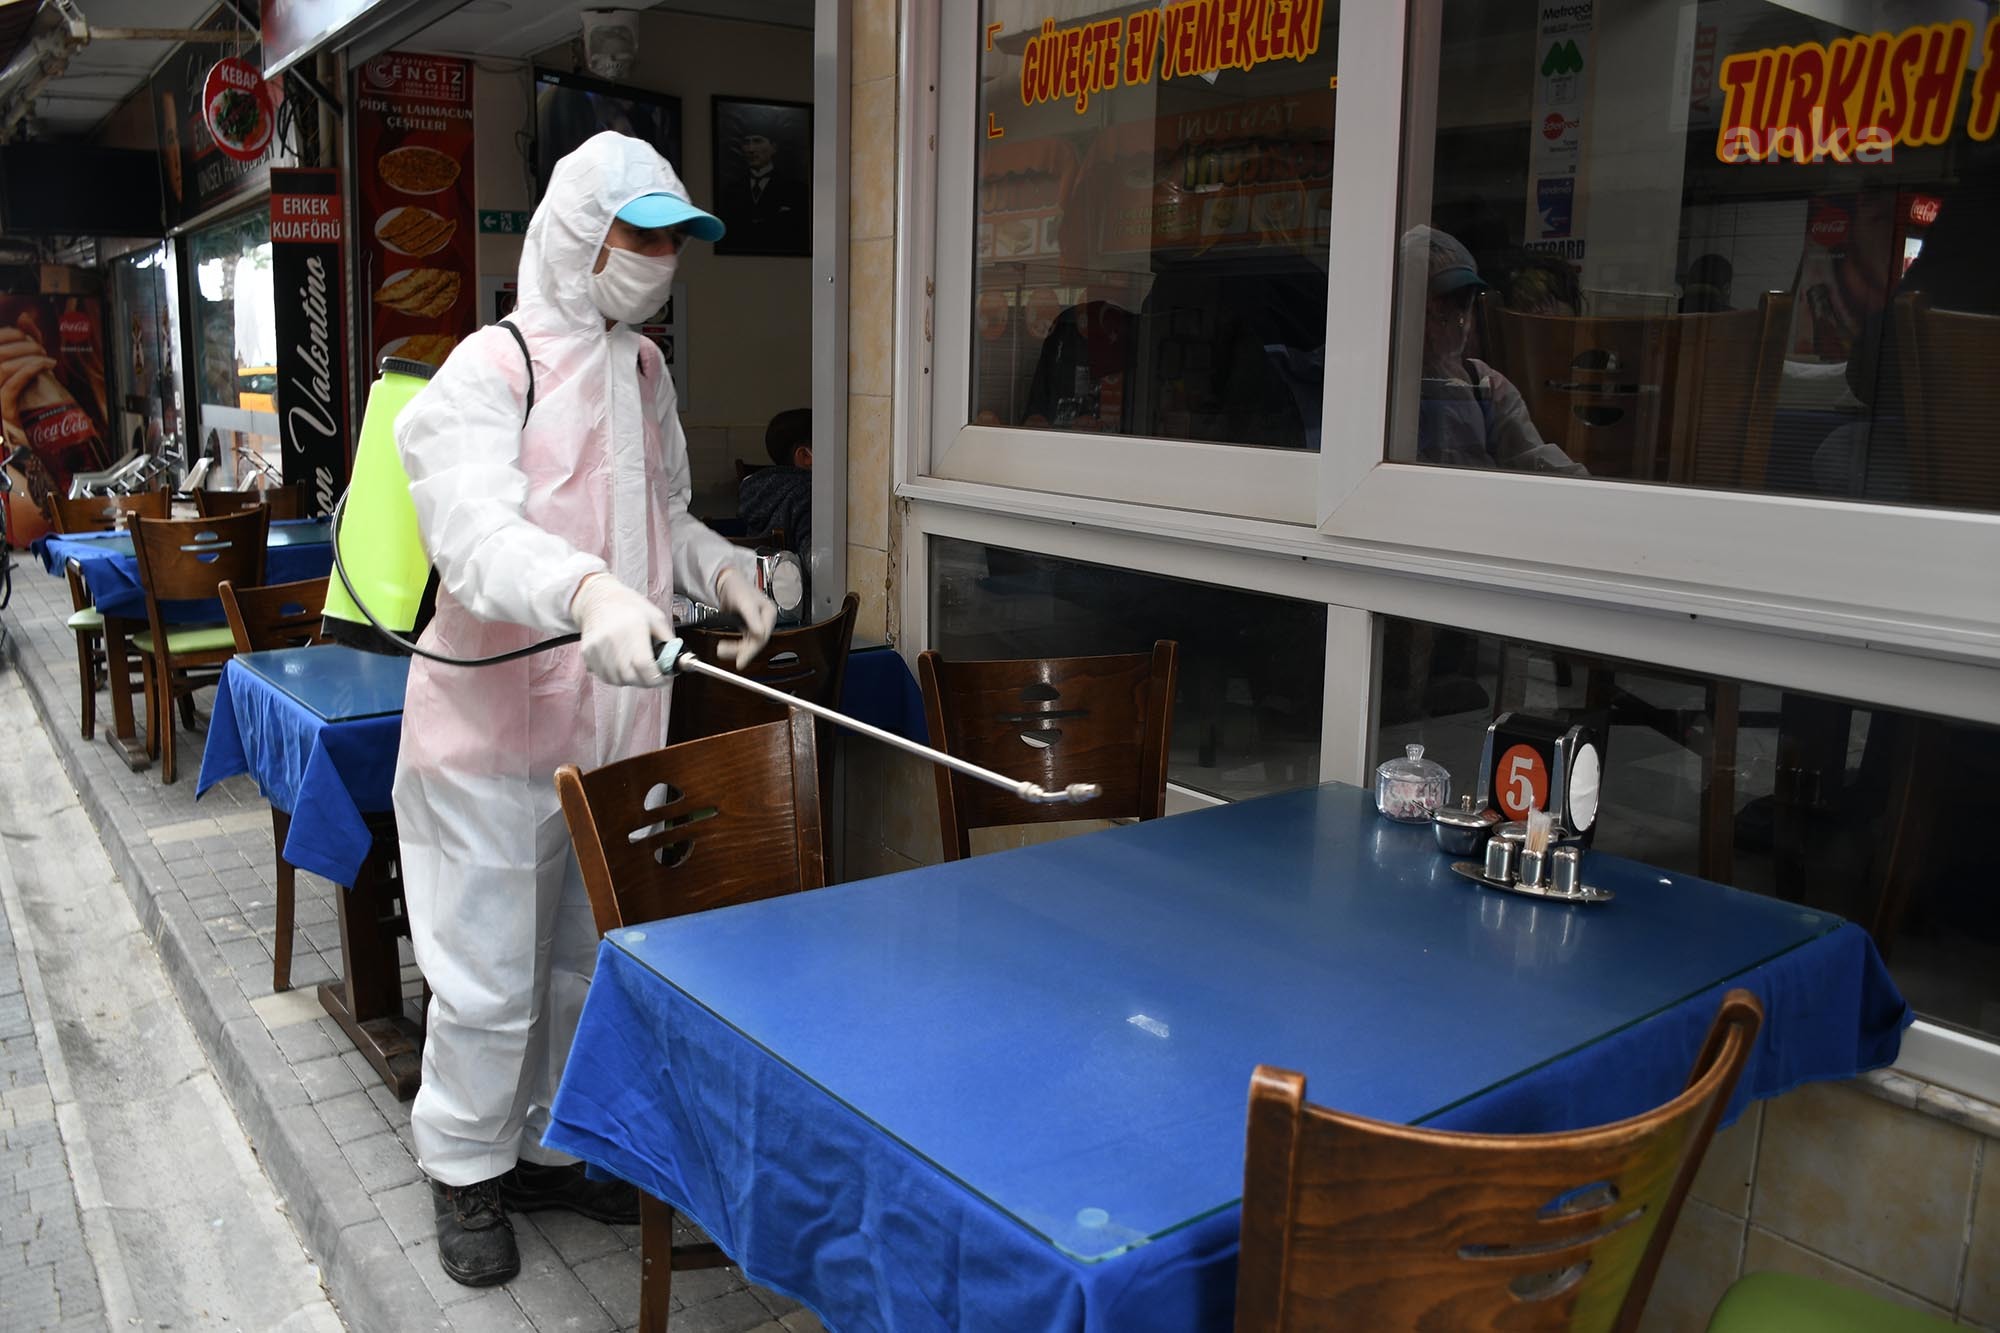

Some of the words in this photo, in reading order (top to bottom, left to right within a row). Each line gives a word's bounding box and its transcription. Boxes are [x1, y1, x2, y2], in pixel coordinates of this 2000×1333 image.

[221, 64, 258, 90] KEBAP
[1021, 17, 1122, 113] GÜVEÇTE
[1124, 8, 1160, 85] EV
[1716, 19, 1975, 165] TURKISH
[407, 103, 473, 120] LAHMACUN
[283, 197, 329, 215] ERKEK
[272, 218, 341, 240] KUAFÖRÜ
[289, 255, 338, 454] Valentino
[32, 411, 90, 446] Coca-Cola
[1505, 755, 1535, 811] 5
